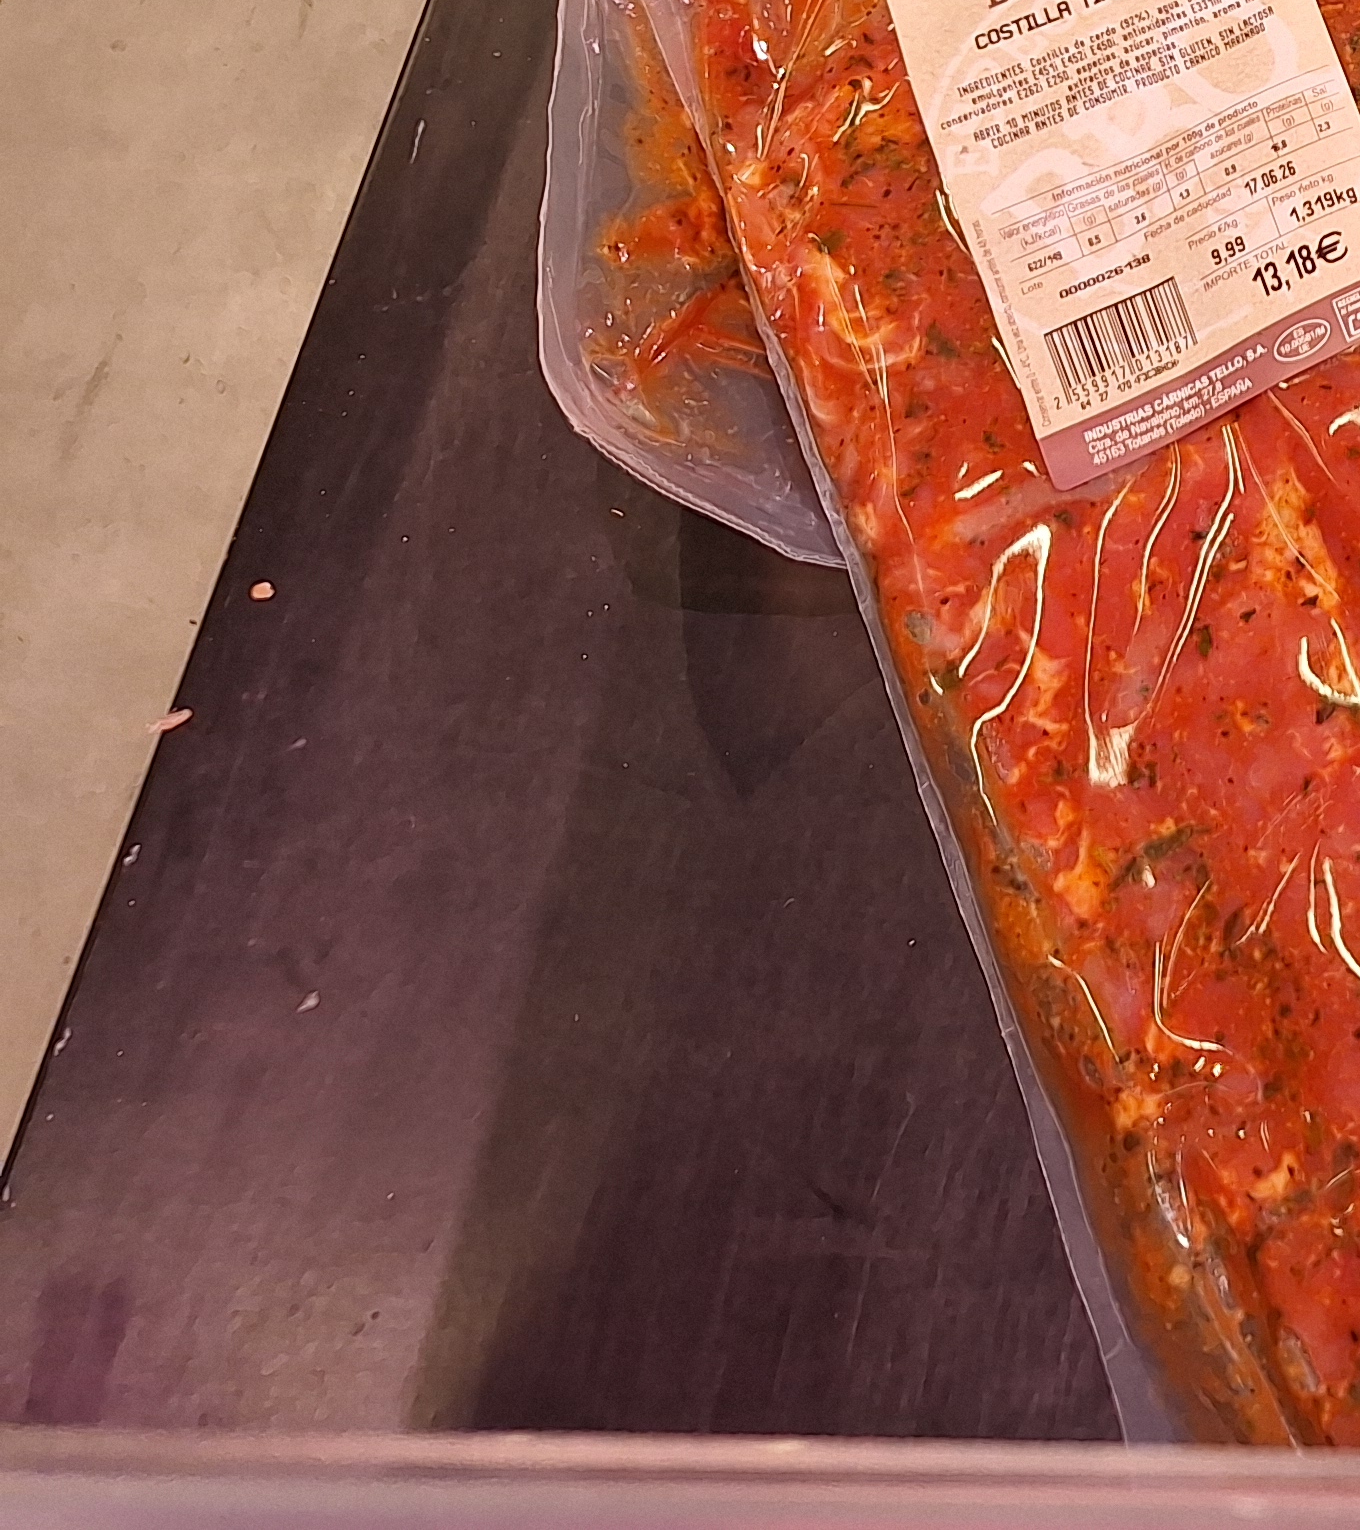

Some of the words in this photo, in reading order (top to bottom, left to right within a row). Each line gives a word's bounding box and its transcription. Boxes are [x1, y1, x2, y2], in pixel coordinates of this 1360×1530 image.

[972, 0, 1072, 51] COSTILLA
[1028, 41, 1073, 69] Costilla
[1072, 35, 1086, 50] de
[1087, 23, 1117, 44] cerdo
[972, 121, 1004, 144] ABRIR
[1004, 115, 1019, 130] 10
[1020, 97, 1063, 125] MINUTOS
[1064, 83, 1095, 107] ANTES
[1096, 77, 1111, 93] DE
[1157, 50, 1177, 67] SIN
[1217, 24, 1236, 42] SIN
[1236, 4, 1275, 33] LACTOSA
[989, 122, 1032, 151] COCINAR
[1033, 108, 1066, 133] ANTES
[1066, 102, 1080, 118] DE
[1133, 62, 1182, 91] PRODUCTO
[1242, 159, 1297, 199] 17.06.26
[1287, 181, 1359, 230] 1,319kg
[1057, 252, 1152, 301] 0000026138
[1201, 258, 1253, 292] IMPORTE
[1252, 239, 1289, 266] TOTAL
[1208, 233, 1248, 269] 9,99
[1248, 227, 1352, 304] 13,18€
[1083, 399, 1153, 445] INDUSTRIAS
[1151, 368, 1210, 410] CÁRNICAS
[1208, 351, 1247, 383] TELLO,
[1244, 340, 1268, 362] S.A.
